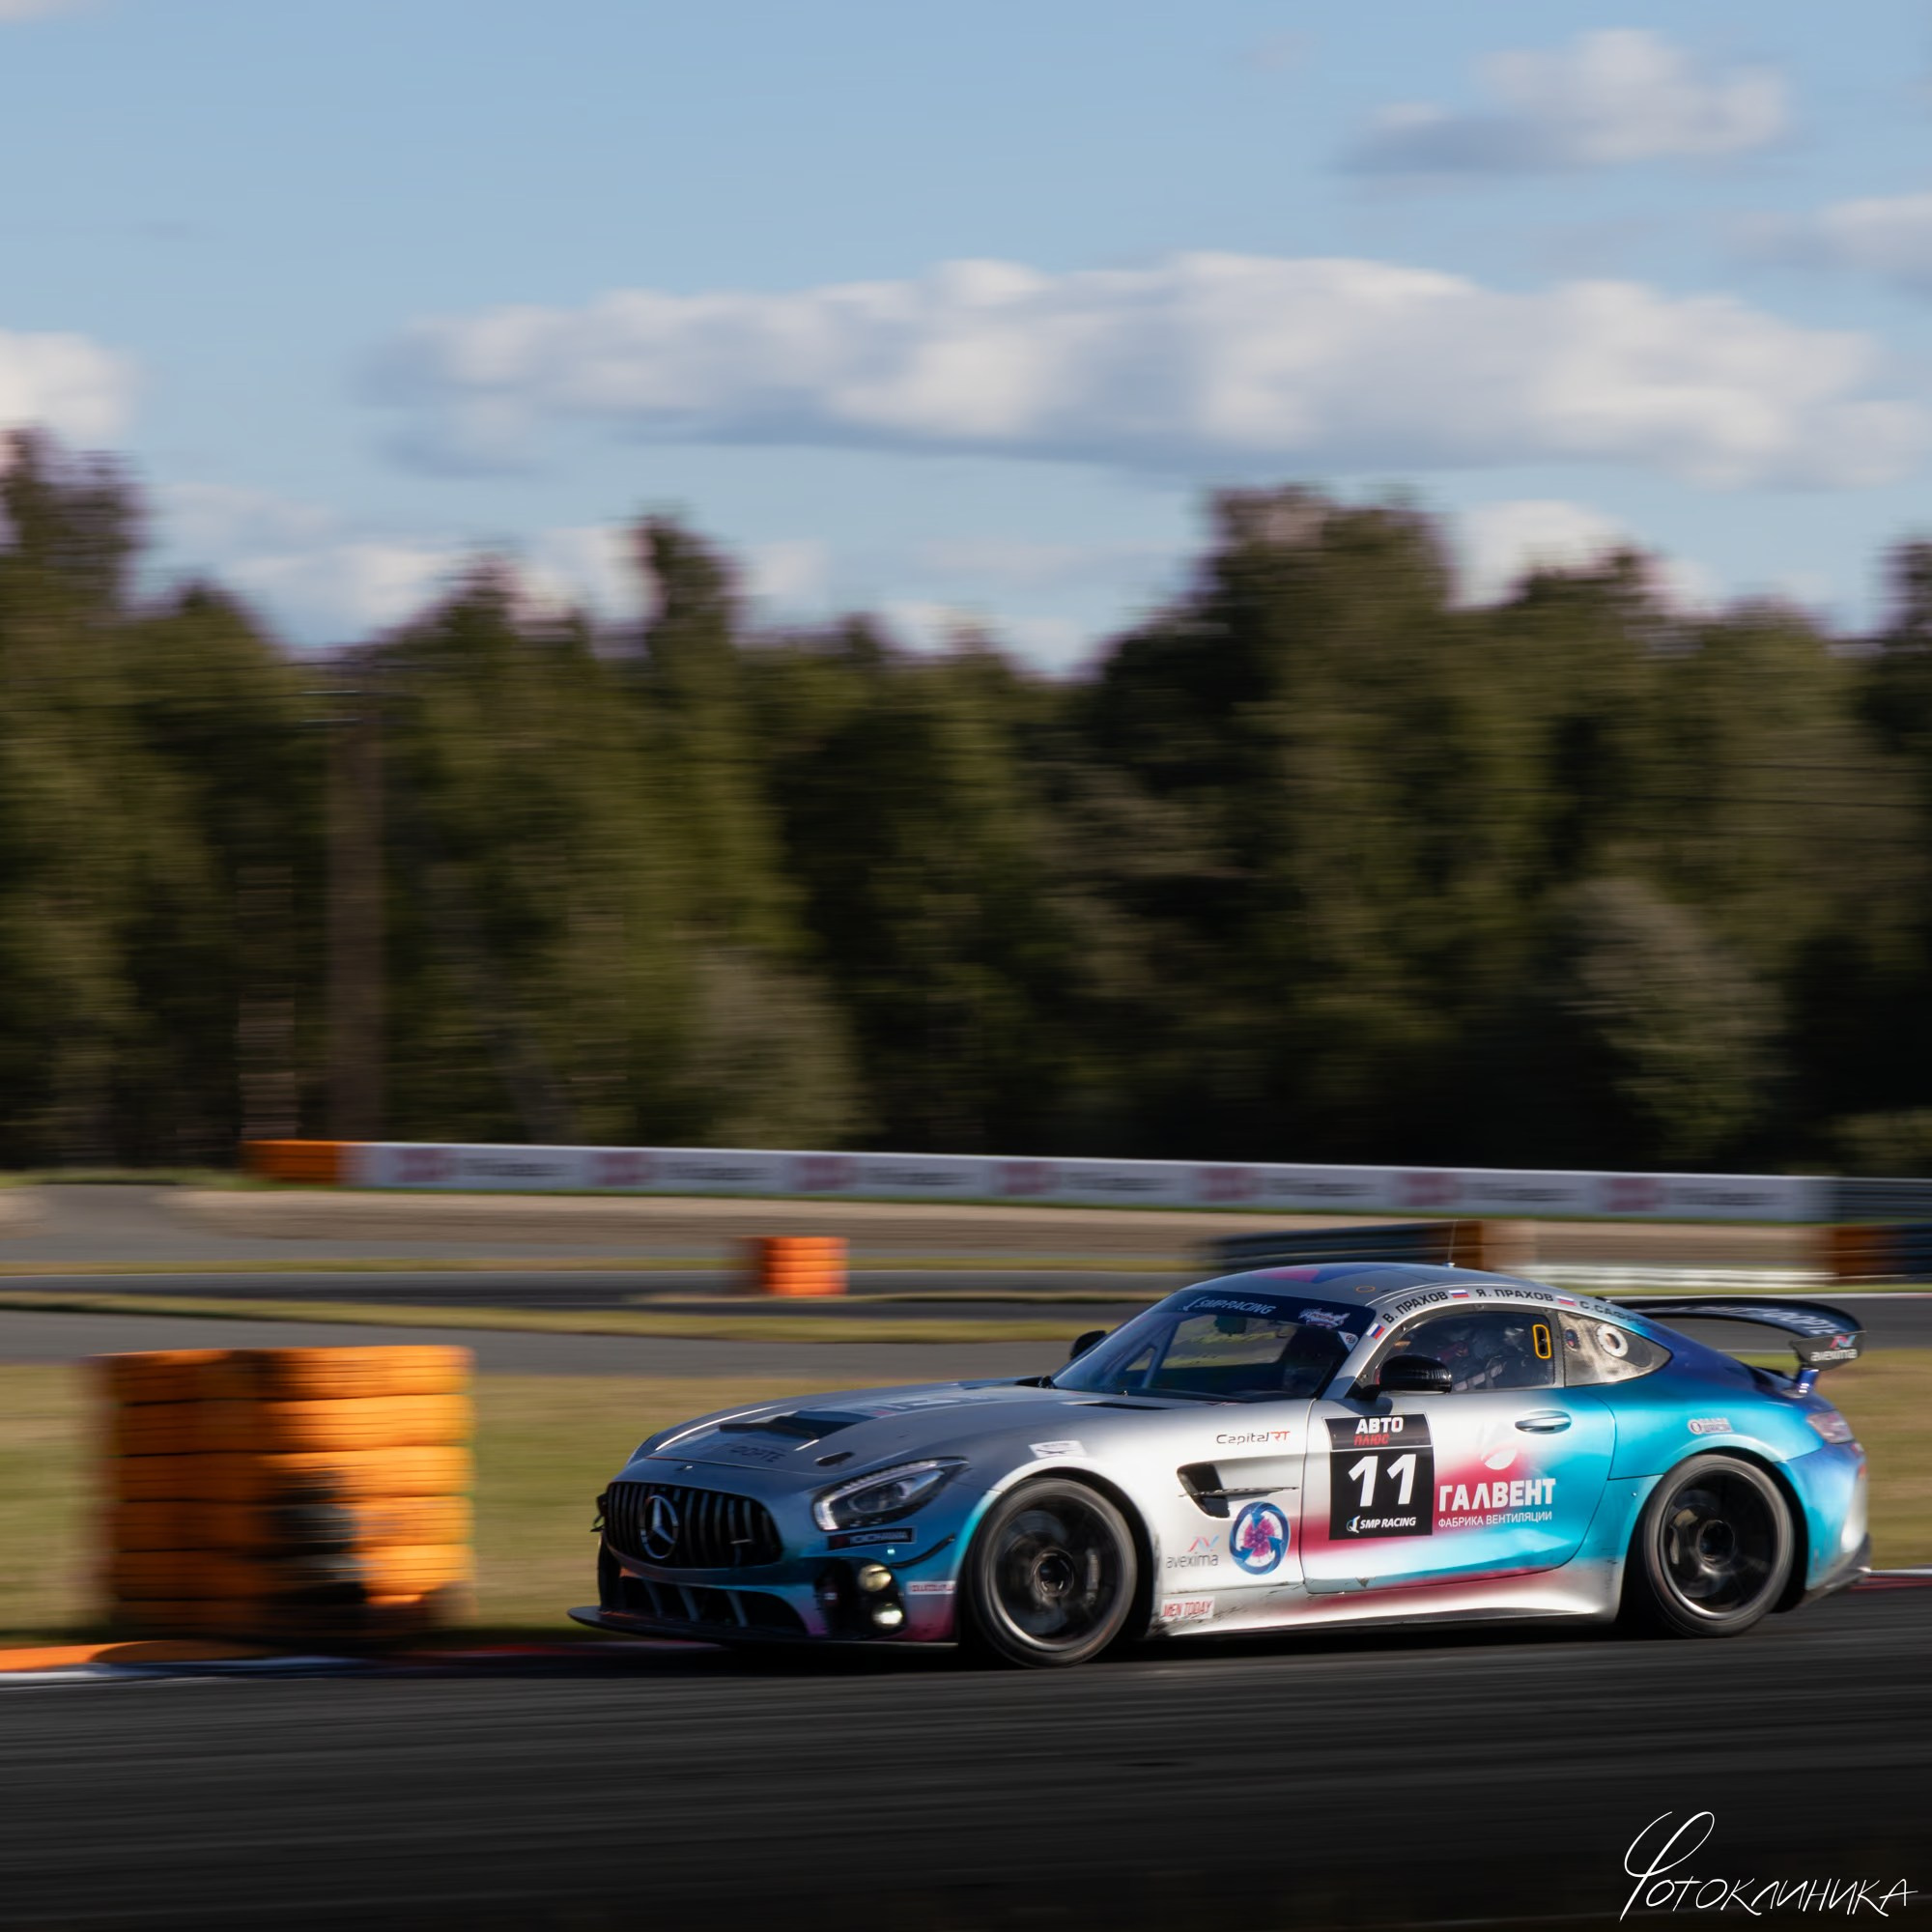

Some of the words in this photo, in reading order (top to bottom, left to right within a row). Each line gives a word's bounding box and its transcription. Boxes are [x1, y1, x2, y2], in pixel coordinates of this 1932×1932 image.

[1475, 1289, 1492, 1298] Я.
[1495, 1289, 1554, 1302] ПРАХОВ
[1222, 1300, 1277, 1315] RACING
[1382, 1312, 1399, 1324] В.
[1396, 1291, 1449, 1315] ПРАХОВ
[1355, 1416, 1404, 1435] АВТО
[1353, 1434, 1390, 1446] ПЛЮС
[1348, 1453, 1417, 1508] 11
[1438, 1477, 1556, 1512] ГАЛВЕНТ
[1359, 1519, 1381, 1530] SMP
[1381, 1517, 1417, 1528] RACING
[1437, 1516, 1484, 1528] ФАБРИКА
[1486, 1510, 1553, 1524] ВЕНТИЛЯЦИИ
[1165, 1551, 1219, 1569] avexima
